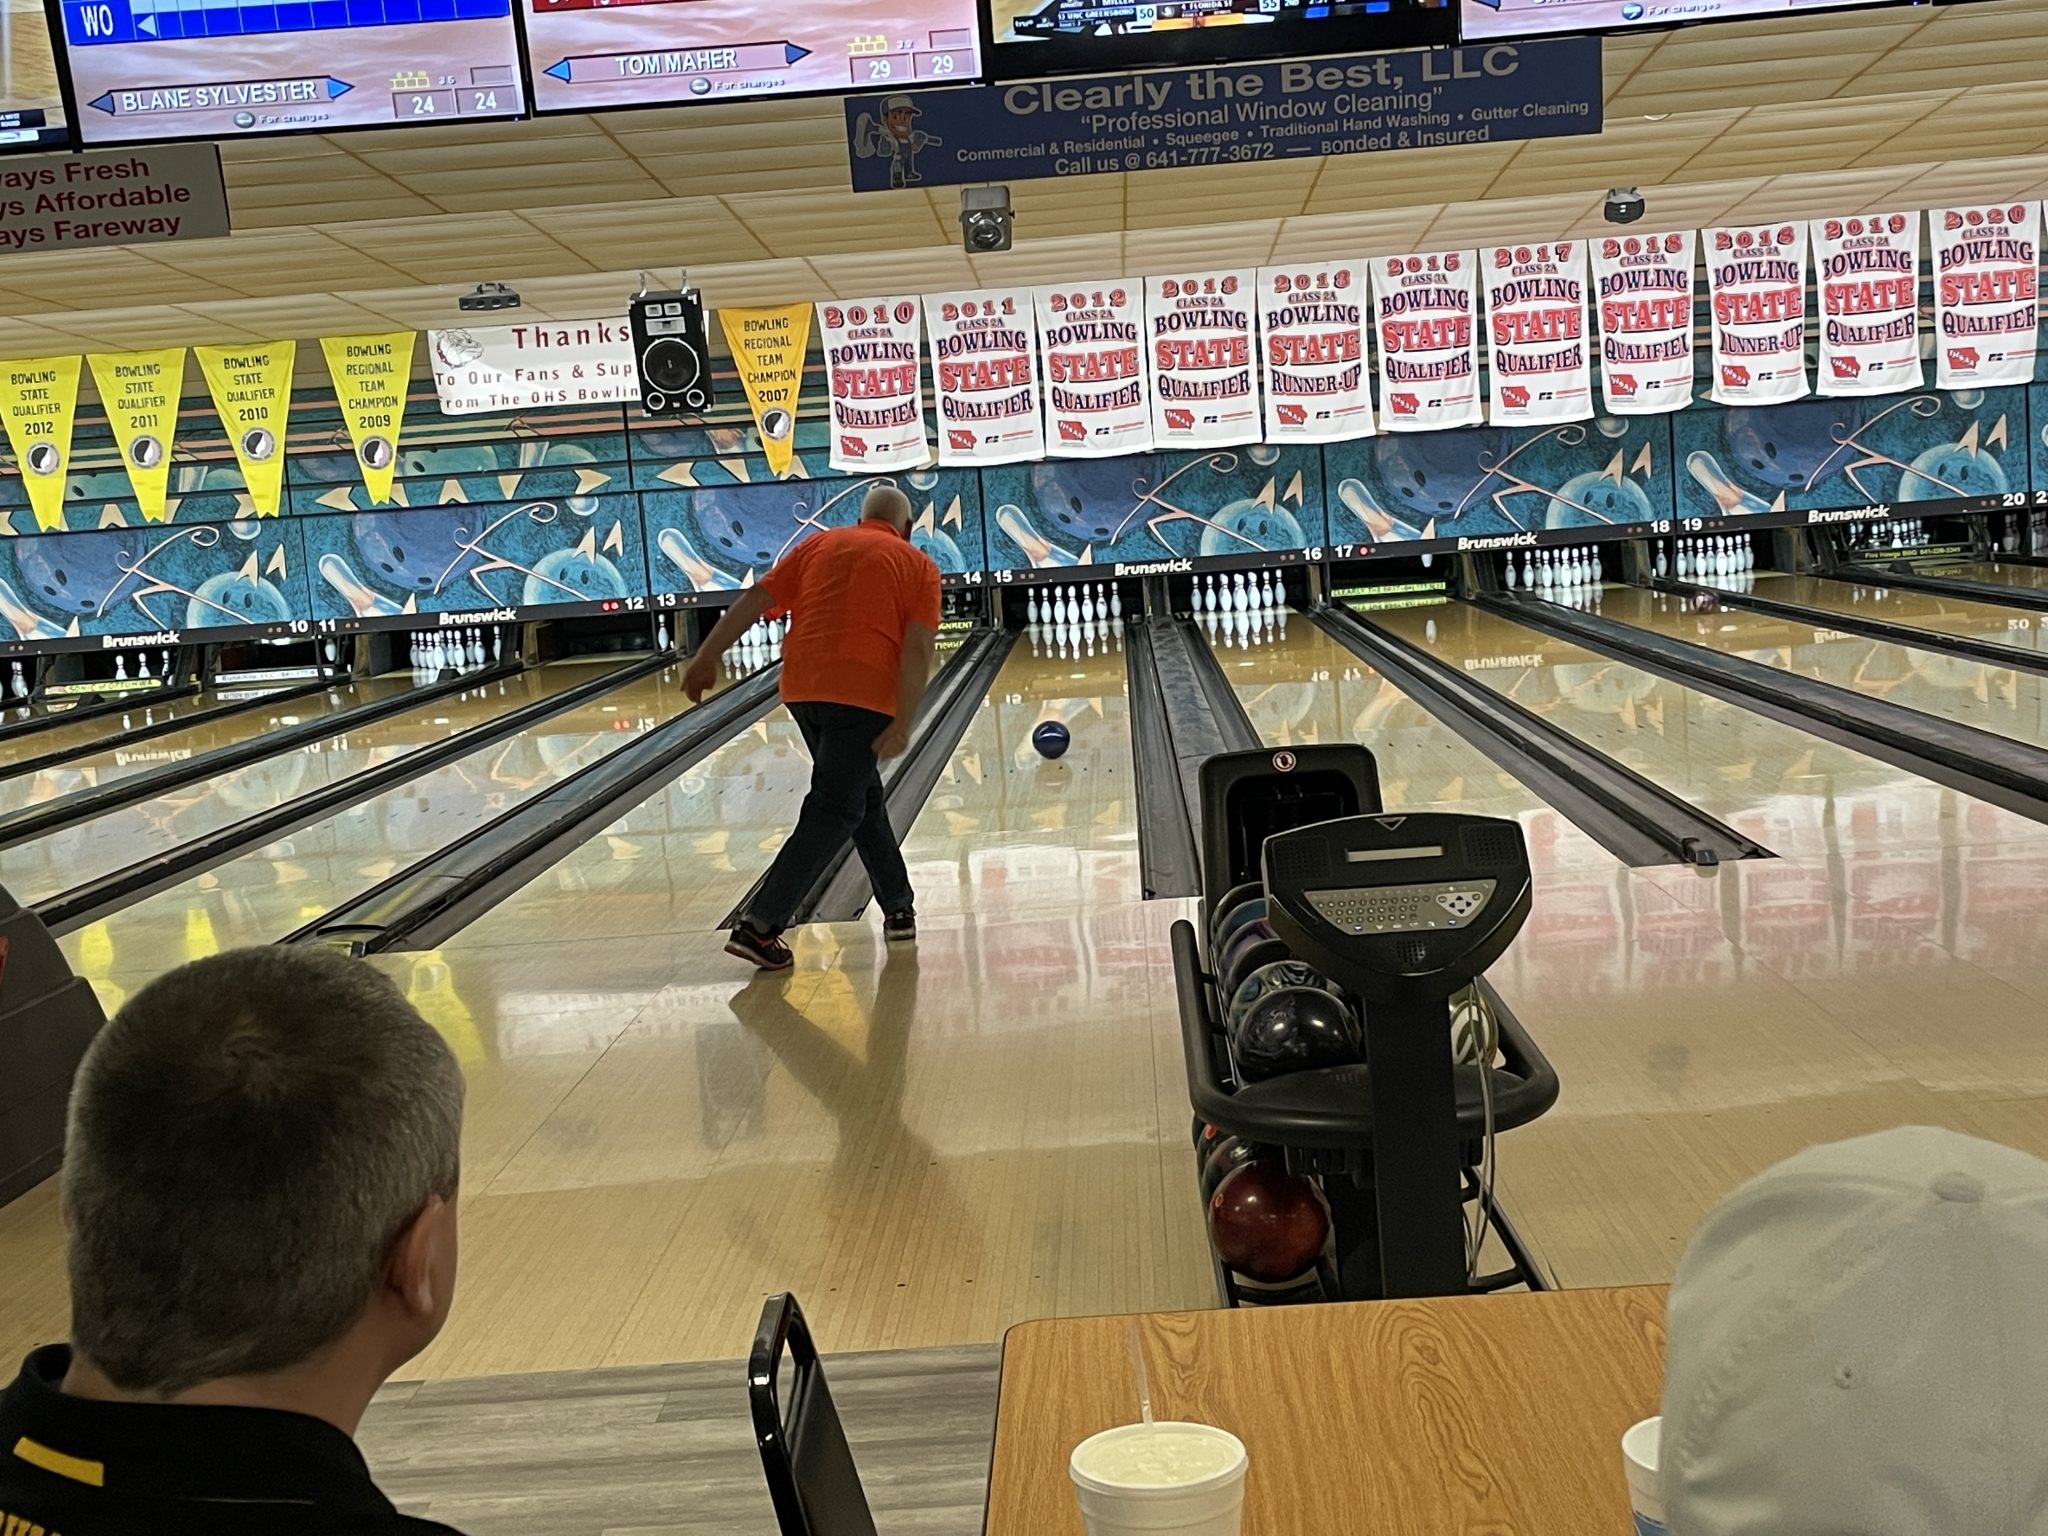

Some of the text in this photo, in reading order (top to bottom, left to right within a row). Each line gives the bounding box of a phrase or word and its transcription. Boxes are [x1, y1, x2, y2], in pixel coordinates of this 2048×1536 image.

[80, 4, 113, 37] WO
[1140, 8, 1154, 18] 50
[615, 49, 738, 76] TOM MAHER
[869, 60, 891, 79] 29
[932, 55, 954, 74] 29
[1004, 45, 1519, 115] Clearly the Best, LLC
[123, 81, 317, 111] BLANE SYLVESTER
[412, 95, 434, 114] 24
[474, 91, 497, 110] 24
[259, 114, 280, 124] For
[1236, 99, 1326, 121] Window
[957, 102, 1589, 162] Commercial & Residential Squeegee Traditional Hand Washing Gutter Cleaning
[1055, 156, 1091, 175] Call
[1097, 158, 1119, 171] us
[1125, 154, 1140, 169] @
[1147, 144, 1274, 166] 641-777-3672
[1397, 132, 1410, 147] &
[1417, 126, 1489, 147] Insured
[0, 158, 149, 190] ays Fresh
[35, 184, 191, 214] Affordable
[1825, 214, 1906, 240] 2019
[1945, 205, 2026, 230] 2020
[54, 217, 180, 240] Fareway
[1603, 234, 1683, 258] 2018
[1843, 237, 1890, 250] CLASS 2A
[1387, 254, 1460, 276] 2015
[1495, 243, 1572, 268] 2017
[1620, 255, 1667, 267] CLASS 2A
[1940, 240, 2033, 272] BOWLING
[1512, 265, 1558, 277] CLASS 2A
[1600, 268, 1688, 298] BOWLING
[1941, 267, 2036, 307] STATE
[1050, 289, 1126, 312] 2012
[1176, 297, 1225, 309] CLASS 2A
[1288, 291, 1337, 304] CLASS 2A
[1381, 289, 1469, 318] BOWLING
[1492, 279, 1581, 309] BOWLING
[1824, 276, 1915, 315] STATE
[942, 297, 1015, 321] 2011
[1602, 295, 1691, 333] STATE
[1715, 286, 1802, 324] STATE
[824, 302, 914, 328] 2010
[956, 317, 1004, 331] CLASS 2A
[1066, 309, 1115, 322] CLASS 2A
[1154, 310, 1248, 336] BOWLING
[1267, 305, 1360, 332] BOWLING
[1943, 304, 2036, 337] QUALIFIER
[744, 318, 789, 332] BOWLING
[1382, 315, 1471, 353] STATE
[1492, 307, 1582, 345] STATE
[1827, 312, 1915, 346] QUALIFIER
[512, 323, 629, 349] Thanks
[744, 335, 792, 350] REGIONAL
[938, 330, 1028, 360] BOWLING
[1048, 323, 1138, 349] BOWLING
[347, 344, 391, 357] BOWLING
[831, 342, 915, 364] BOWLING
[1155, 335, 1249, 370] STATE
[1268, 329, 1360, 366] STATE
[224, 355, 269, 369] BOWLING
[346, 362, 394, 375] REGIONAL
[757, 354, 783, 366] TEAM
[1049, 347, 1140, 383] STATE
[1386, 350, 1472, 382] QUALIFIER
[1497, 343, 1583, 376] QUALIFIER
[11, 371, 56, 385] BOWLING
[115, 364, 160, 377] BOWLING
[233, 373, 263, 385] STATE
[435, 363, 632, 386] To Our Fans & Sup
[748, 368, 797, 383] CHAMPION
[939, 355, 1032, 392] STATE
[1271, 363, 1362, 396] RUNNER-UP
[125, 382, 153, 393] STATE
[358, 379, 385, 392] TEAM
[832, 363, 918, 399] STATE
[1159, 370, 1250, 401] QUALIFIER
[20, 389, 49, 400] STATE
[118, 396, 165, 409] QUALIFIER
[227, 389, 275, 402] QUALIFIER
[349, 396, 398, 410] CHAMPION
[490, 394, 520, 406] The
[531, 390, 567, 404] OHS
[579, 387, 638, 400] Bowlin
[759, 389, 788, 402] 2007
[1052, 381, 1142, 413] QUALIFIER
[13, 403, 61, 416] QUALIFIER
[239, 407, 268, 421] 2010
[942, 389, 1033, 421] QUALIFIER
[25, 422, 53, 435] 2012
[131, 415, 158, 428] 2011
[359, 415, 391, 428] 2009
[2002, 492, 2025, 506] 20
[1808, 506, 1889, 523] Brunswick
[1651, 521, 1670, 533] 18
[1683, 519, 1702, 531] 19
[1458, 532, 1538, 550] Brunswick
[1302, 548, 1322, 561] 16
[1335, 545, 1352, 558] 17
[963, 571, 982, 584] 14
[994, 570, 1012, 583] 15
[1114, 559, 1192, 577] Brunswick
[625, 597, 644, 610] 12
[657, 594, 675, 607] 13
[318, 619, 336, 632] 11
[439, 608, 516, 624] Brunswick
[289, 621, 308, 633] 10
[103, 630, 180, 648] Brunswick
